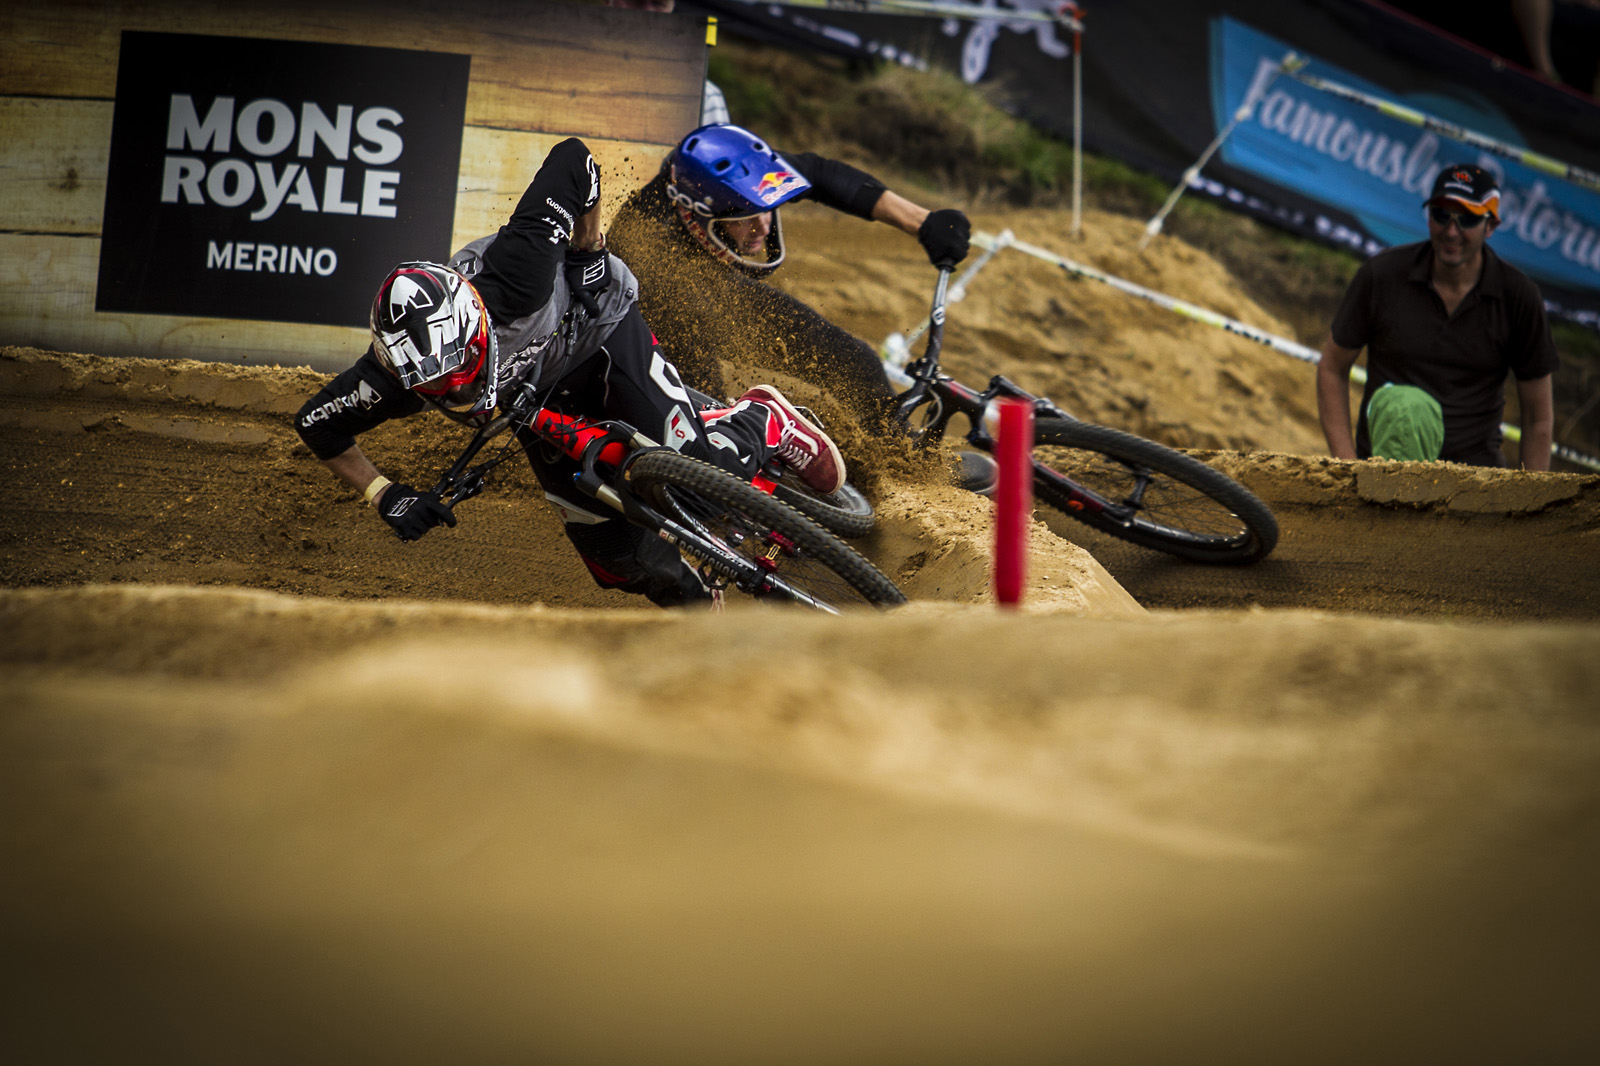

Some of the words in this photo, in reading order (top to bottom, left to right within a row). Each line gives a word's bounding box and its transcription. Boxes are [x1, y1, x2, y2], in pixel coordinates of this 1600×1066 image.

[166, 94, 404, 165] MONS
[161, 156, 401, 221] ROYALE
[206, 240, 338, 277] MERINO
